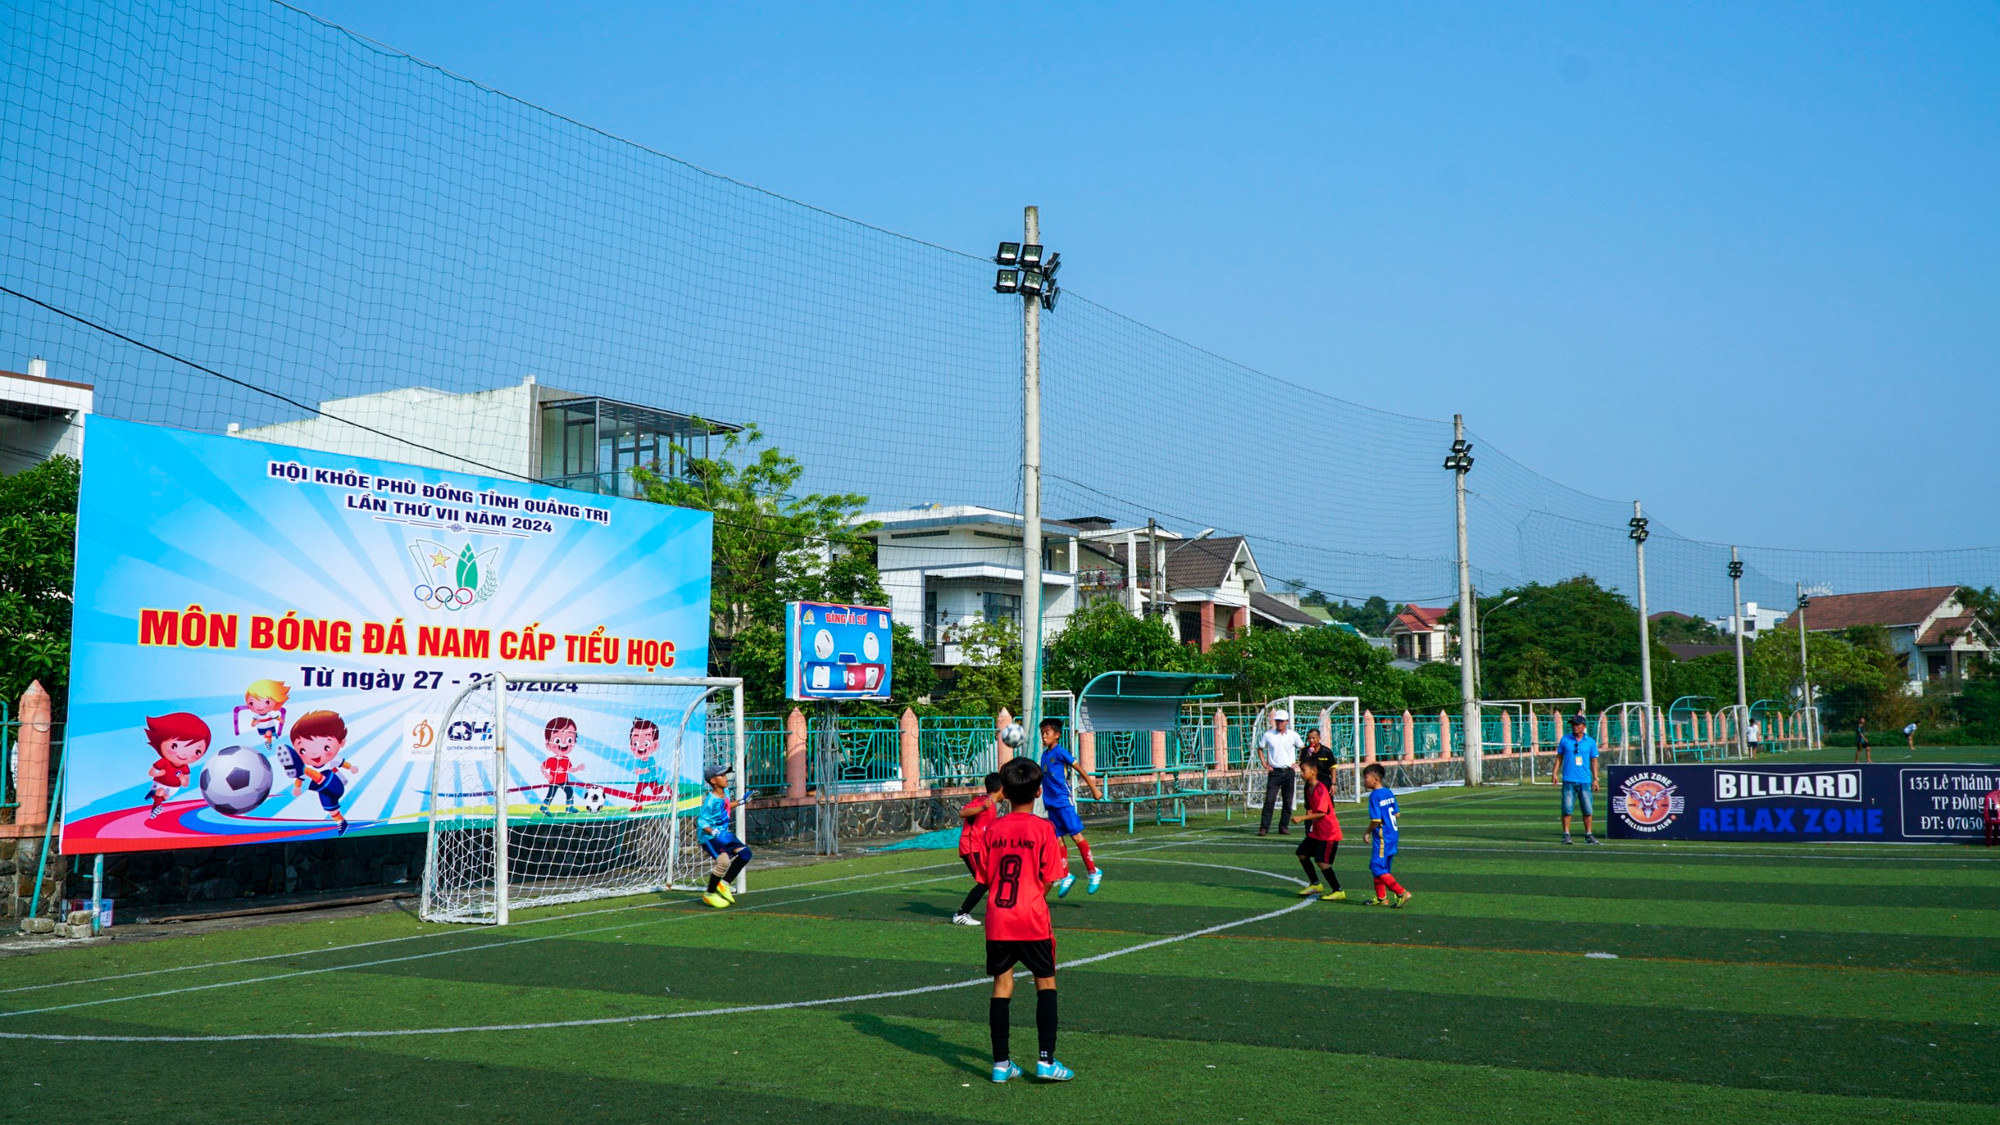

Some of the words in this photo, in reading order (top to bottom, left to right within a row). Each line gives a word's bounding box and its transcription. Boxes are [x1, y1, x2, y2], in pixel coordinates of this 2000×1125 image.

[270, 462, 308, 482] HỘI
[315, 469, 370, 489] KHỎE
[376, 479, 416, 495] PHÙ
[422, 482, 474, 503] ĐỔNG
[479, 490, 519, 510] TỈNH
[524, 498, 580, 518] QUẢNG
[584, 507, 608, 524] TRỊ
[347, 492, 387, 512] LẦN
[393, 502, 432, 518] THỨ
[436, 507, 459, 522] VII
[465, 510, 506, 528] NĂM
[512, 517, 553, 533] 2024
[139, 604, 239, 649] MÔN
[250, 611, 352, 654] BÓNG
[362, 617, 408, 656] ĐÁ
[417, 626, 490, 659] NAM
[500, 622, 556, 662] CẤP
[564, 624, 620, 665] TIỂU
[626, 638, 676, 673] HỌC
[300, 666, 335, 687] Từ
[342, 670, 406, 691] ngày
[413, 670, 444, 690] 27
[843, 670, 856, 686] VS
[1624, 772, 1649, 786] RELAX
[1651, 772, 1672, 786] ZONE
[1718, 774, 1858, 798] BILLIARD
[1908, 776, 1930, 790] 135
[1932, 773, 1949, 790] Lê
[1952, 773, 1992, 790] Thánh
[1932, 796, 1948, 810] TP
[1624, 818, 1656, 832] BILLIARDS
[1656, 818, 1672, 830] CLUB
[1700, 808, 1796, 832] RELAX
[1802, 808, 1884, 834] ZONE
[1920, 816, 1944, 830] ĐT:
[994, 854, 1022, 909] 8
